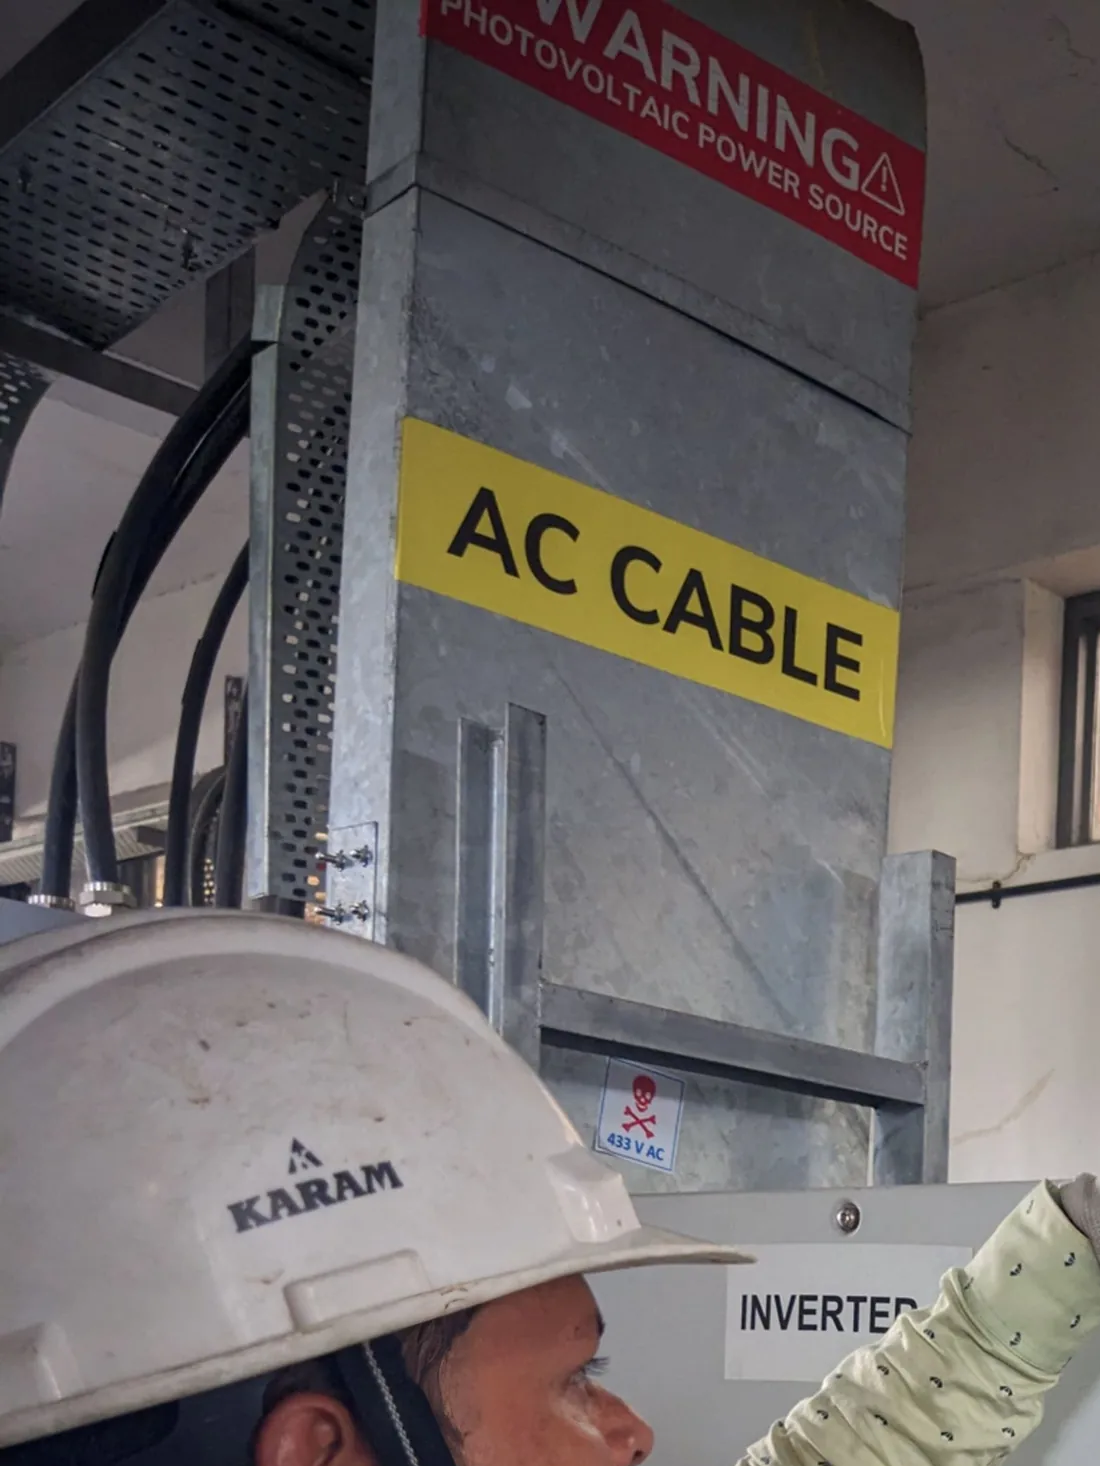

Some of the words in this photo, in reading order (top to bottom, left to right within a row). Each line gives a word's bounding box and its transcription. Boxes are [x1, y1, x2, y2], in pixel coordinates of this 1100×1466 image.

[698, 121, 802, 200] POWER
[808, 182, 909, 262] SOURCE
[446, 486, 580, 595] AC
[610, 545, 864, 702] CABLE
[227, 1160, 404, 1233] KARAM
[607, 1132, 631, 1151] 433
[635, 1140, 644, 1154] V
[646, 1145, 665, 1161] AC
